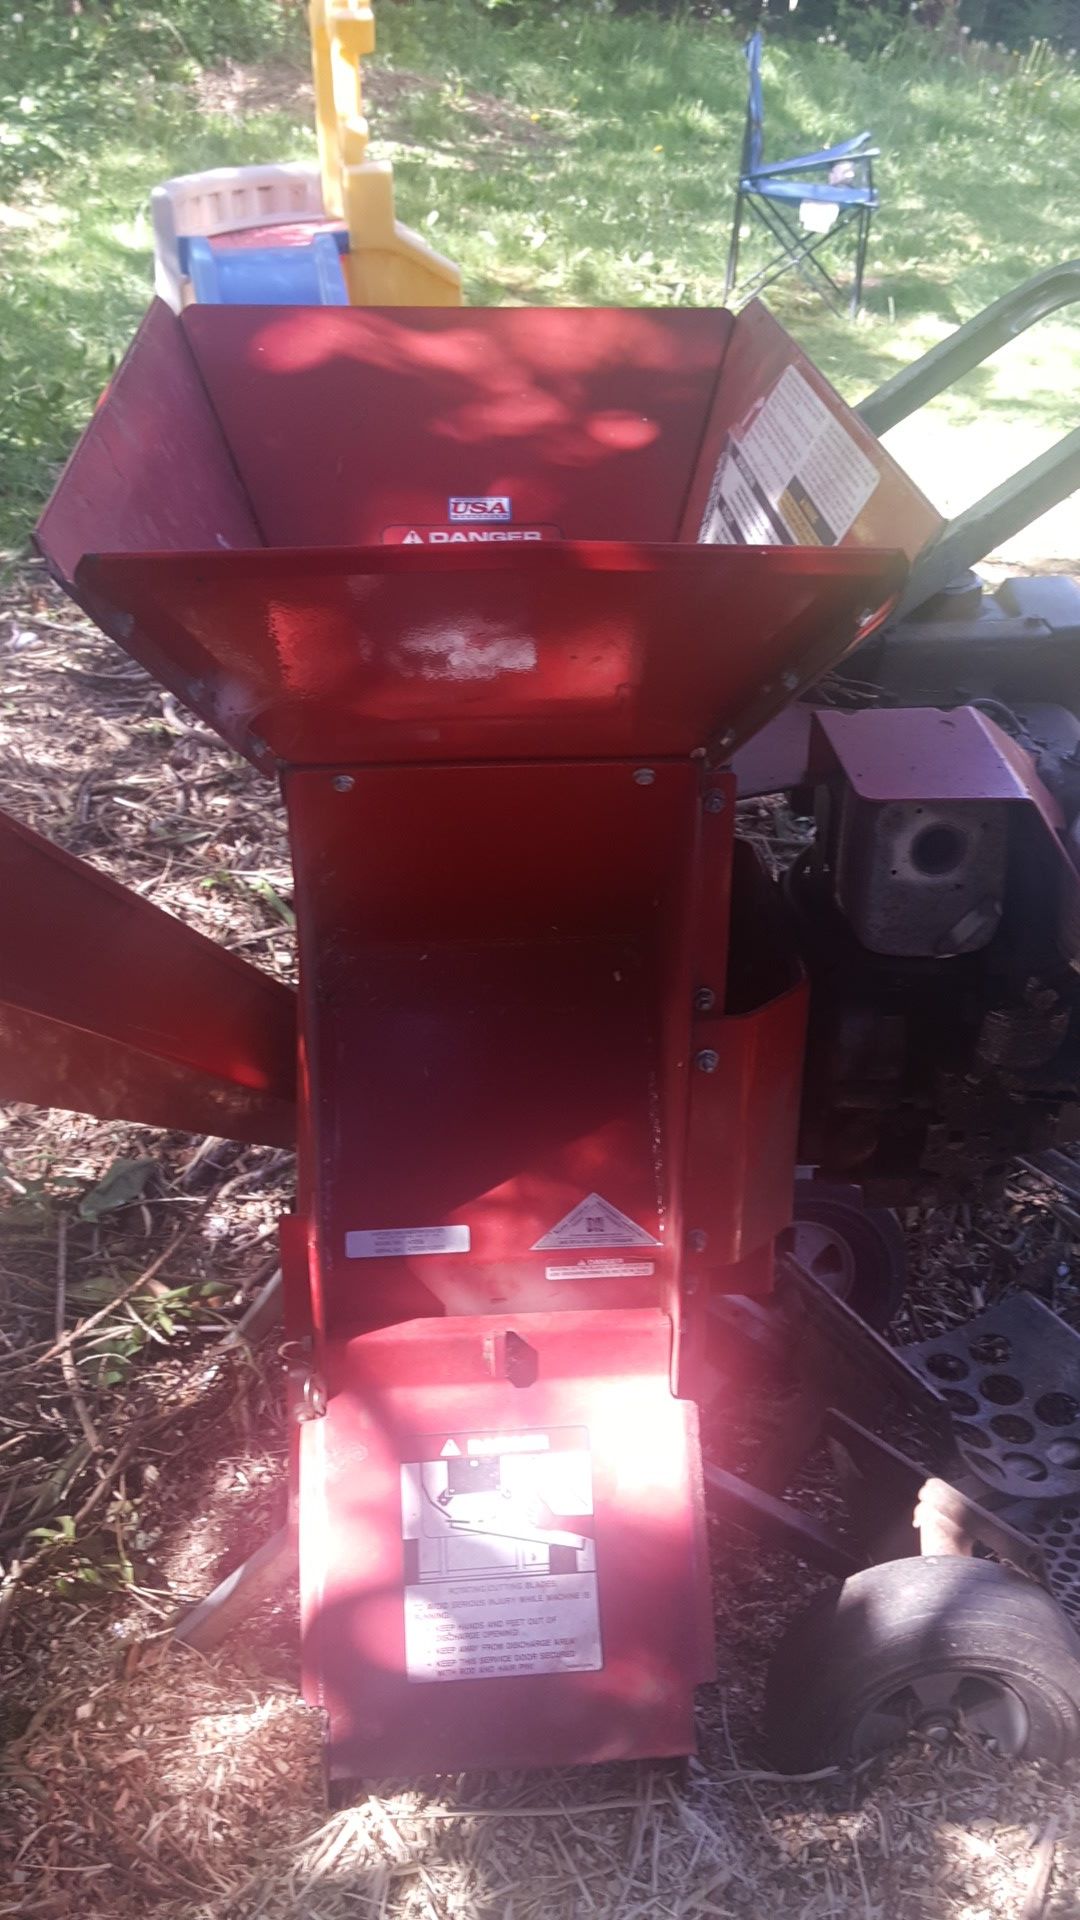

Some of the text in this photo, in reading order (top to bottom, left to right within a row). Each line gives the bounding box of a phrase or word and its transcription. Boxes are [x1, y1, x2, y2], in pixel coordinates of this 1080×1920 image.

[451, 501, 507, 514] USA
[429, 531, 542, 543] DANGER
[451, 1599, 487, 1609] SERIOUS
[546, 1592, 581, 1601] MACHINE
[457, 1622, 485, 1631] HANDS
[481, 1642, 505, 1651] FROM
[505, 1639, 552, 1650] DISCHARGE
[479, 1654, 512, 1664] SERVICE
[514, 1652, 537, 1662] DOOR
[539, 1650, 576, 1660] SECURED
